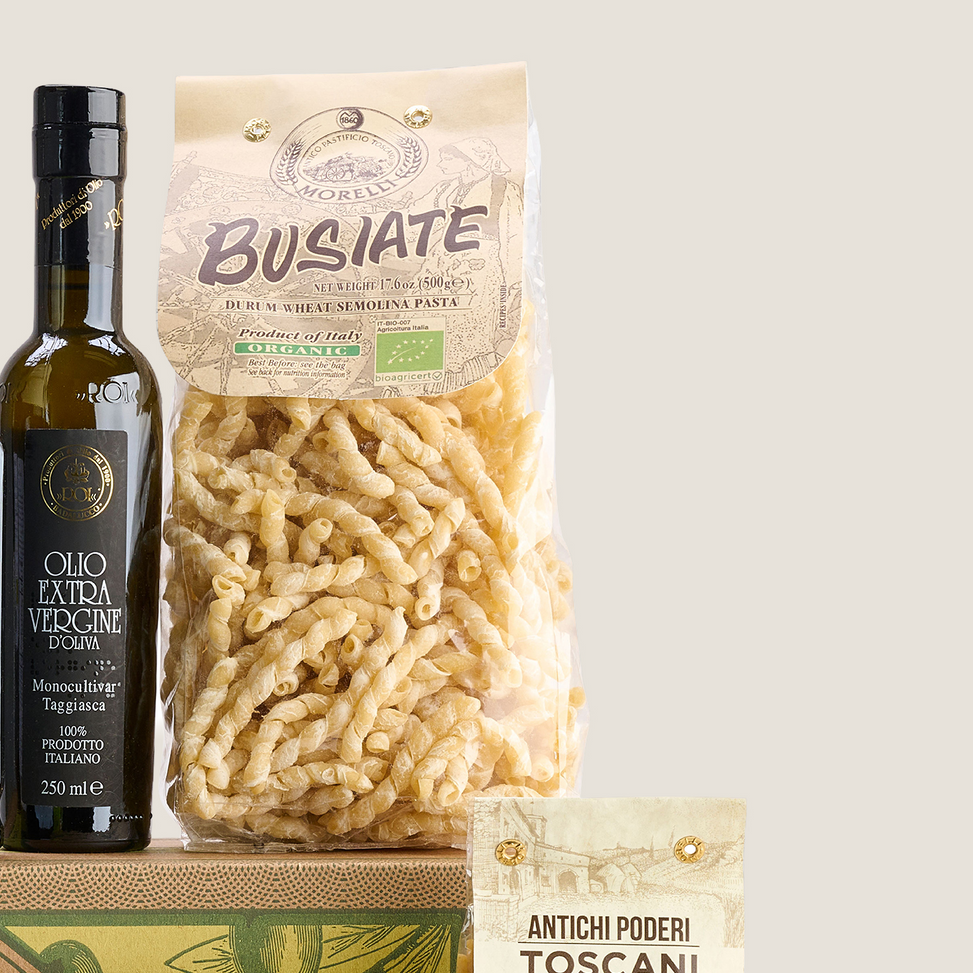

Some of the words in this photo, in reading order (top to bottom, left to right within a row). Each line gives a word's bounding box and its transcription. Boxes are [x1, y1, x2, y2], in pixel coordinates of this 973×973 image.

[300, 179, 399, 202] MORELLI
[197, 203, 490, 288] BUSIATE
[225, 298, 277, 313] DURUM
[282, 300, 332, 313] WHEAT
[337, 298, 411, 312] SEMOLINA
[415, 297, 458, 308] PASTA
[247, 342, 347, 356] ORGANIC
[44, 551, 106, 578] OLIO
[38, 579, 112, 605] EXTRA
[28, 607, 121, 634] VERGINE
[49, 635, 100, 650] D'OLIVA
[32, 679, 116, 693] Monocultivar
[42, 697, 105, 714] Taggiasca
[59, 726, 87, 737] 100%
[42, 739, 104, 750] PRODOTTO
[45, 753, 101, 764] ITALIANO
[41, 780, 65, 795] 250
[69, 781, 87, 795] ml
[528, 914, 610, 940] ANTICHI
[617, 916, 690, 942] PODERI
